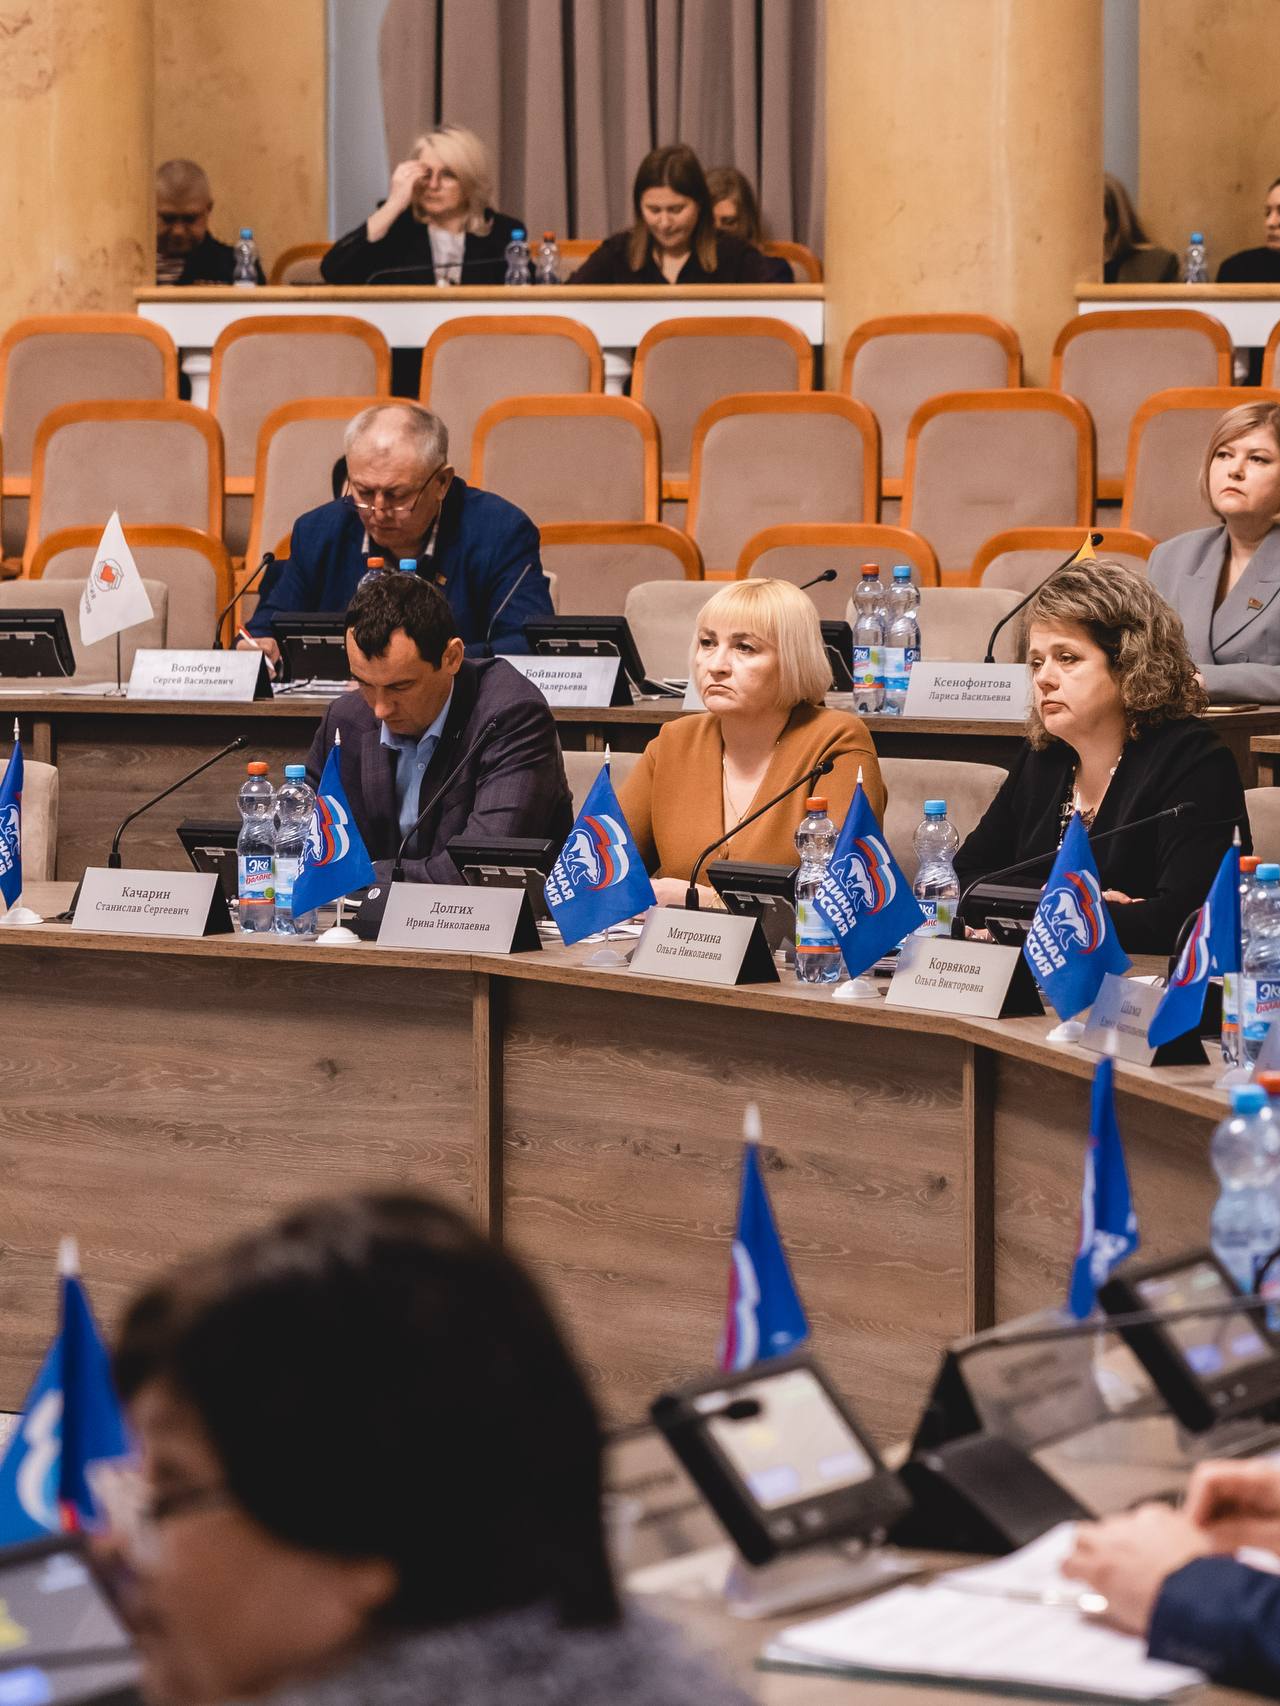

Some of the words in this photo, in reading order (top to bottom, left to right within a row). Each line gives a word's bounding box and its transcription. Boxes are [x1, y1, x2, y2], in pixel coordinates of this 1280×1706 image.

[171, 663, 221, 674] Волобуев
[525, 668, 582, 679] Бойванова
[153, 676, 182, 687] Сергей
[184, 677, 234, 687] Васильевич
[539, 682, 588, 692] Валерьевна
[933, 677, 1011, 692] Ксенофонтова
[928, 691, 959, 702] Лариса
[961, 692, 1011, 702] Васильевна
[121, 886, 171, 901] Качарин
[95, 901, 142, 913] Станислав
[143, 904, 189, 916] Сергеевич
[430, 902, 474, 915] Долгих
[815, 887, 849, 937] ОССИЯ
[406, 917, 435, 930] Ирина
[436, 919, 490, 932] Николаевна
[667, 927, 722, 944] Митрохина
[656, 943, 677, 956] Ольга
[678, 946, 722, 961] Николаевна
[929, 957, 981, 975] Корвякова
[914, 974, 937, 986] Ольга
[937, 978, 985, 993] Викторовна
